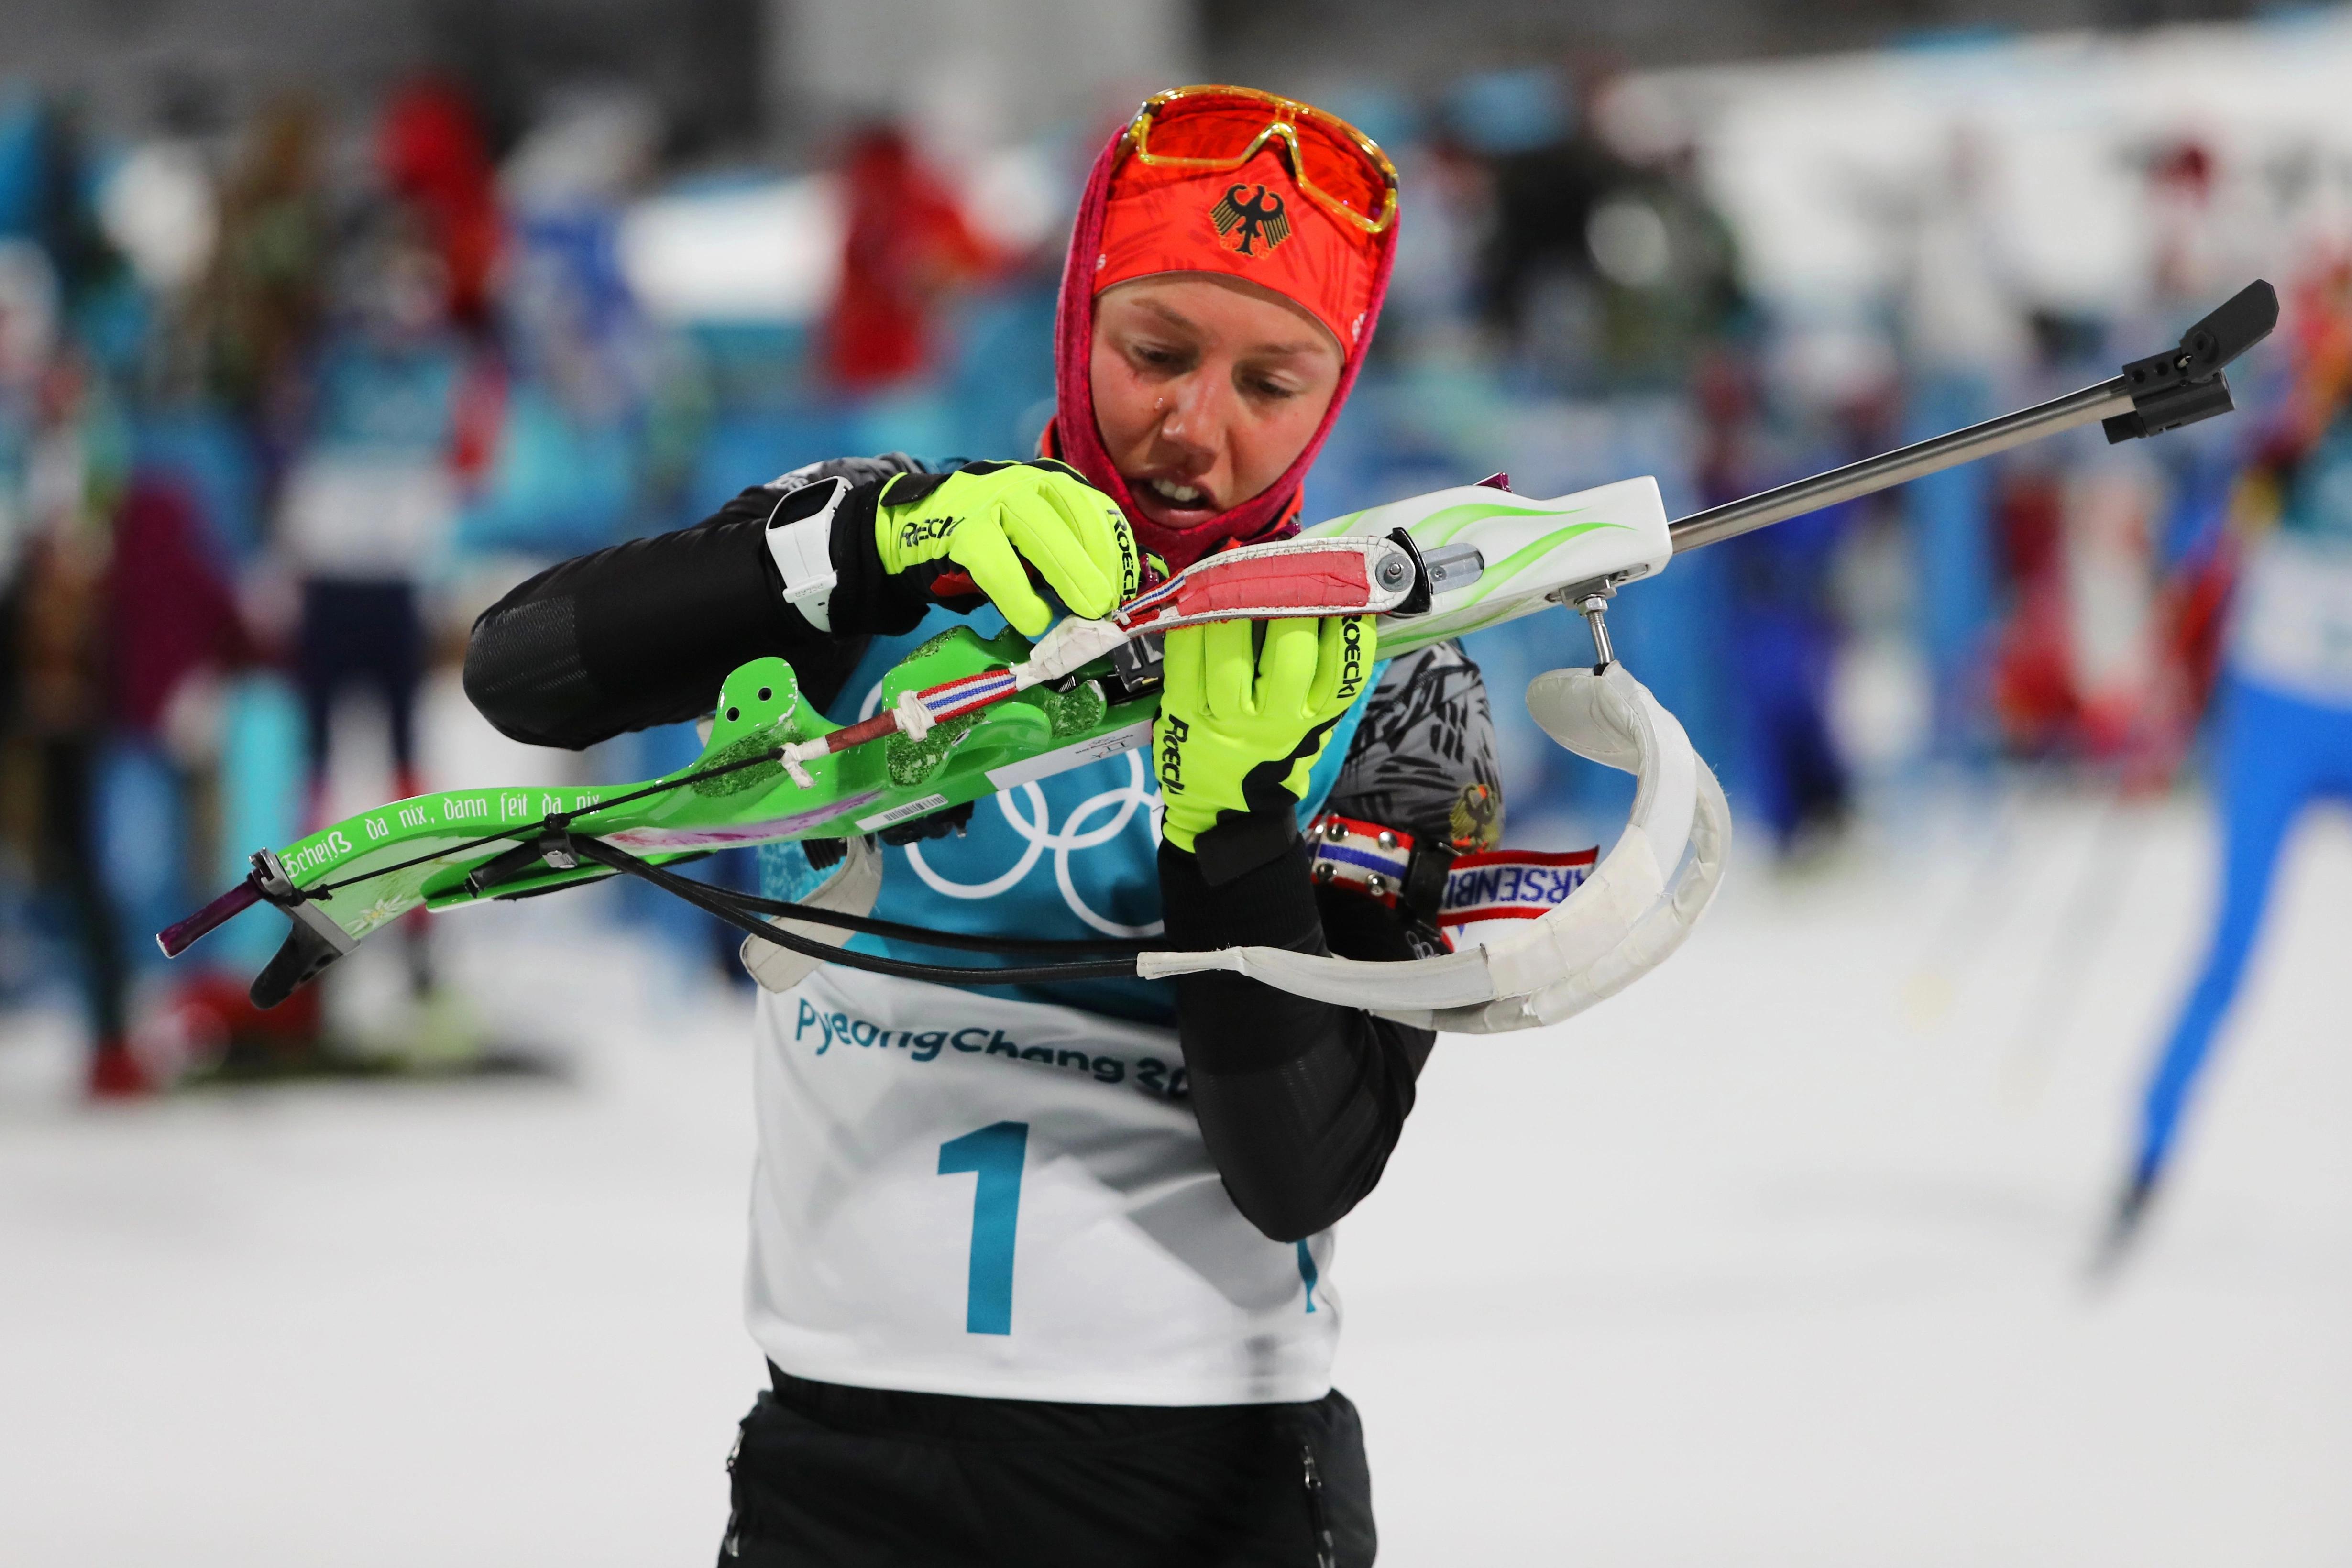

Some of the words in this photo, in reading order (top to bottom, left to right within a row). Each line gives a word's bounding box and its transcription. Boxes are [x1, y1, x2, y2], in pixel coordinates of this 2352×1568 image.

[366, 817, 389, 840] da
[444, 796, 487, 821] dann
[542, 793, 562, 816] da
[795, 998, 1125, 1083] PyeongChang
[937, 1120, 1029, 1336] 1
